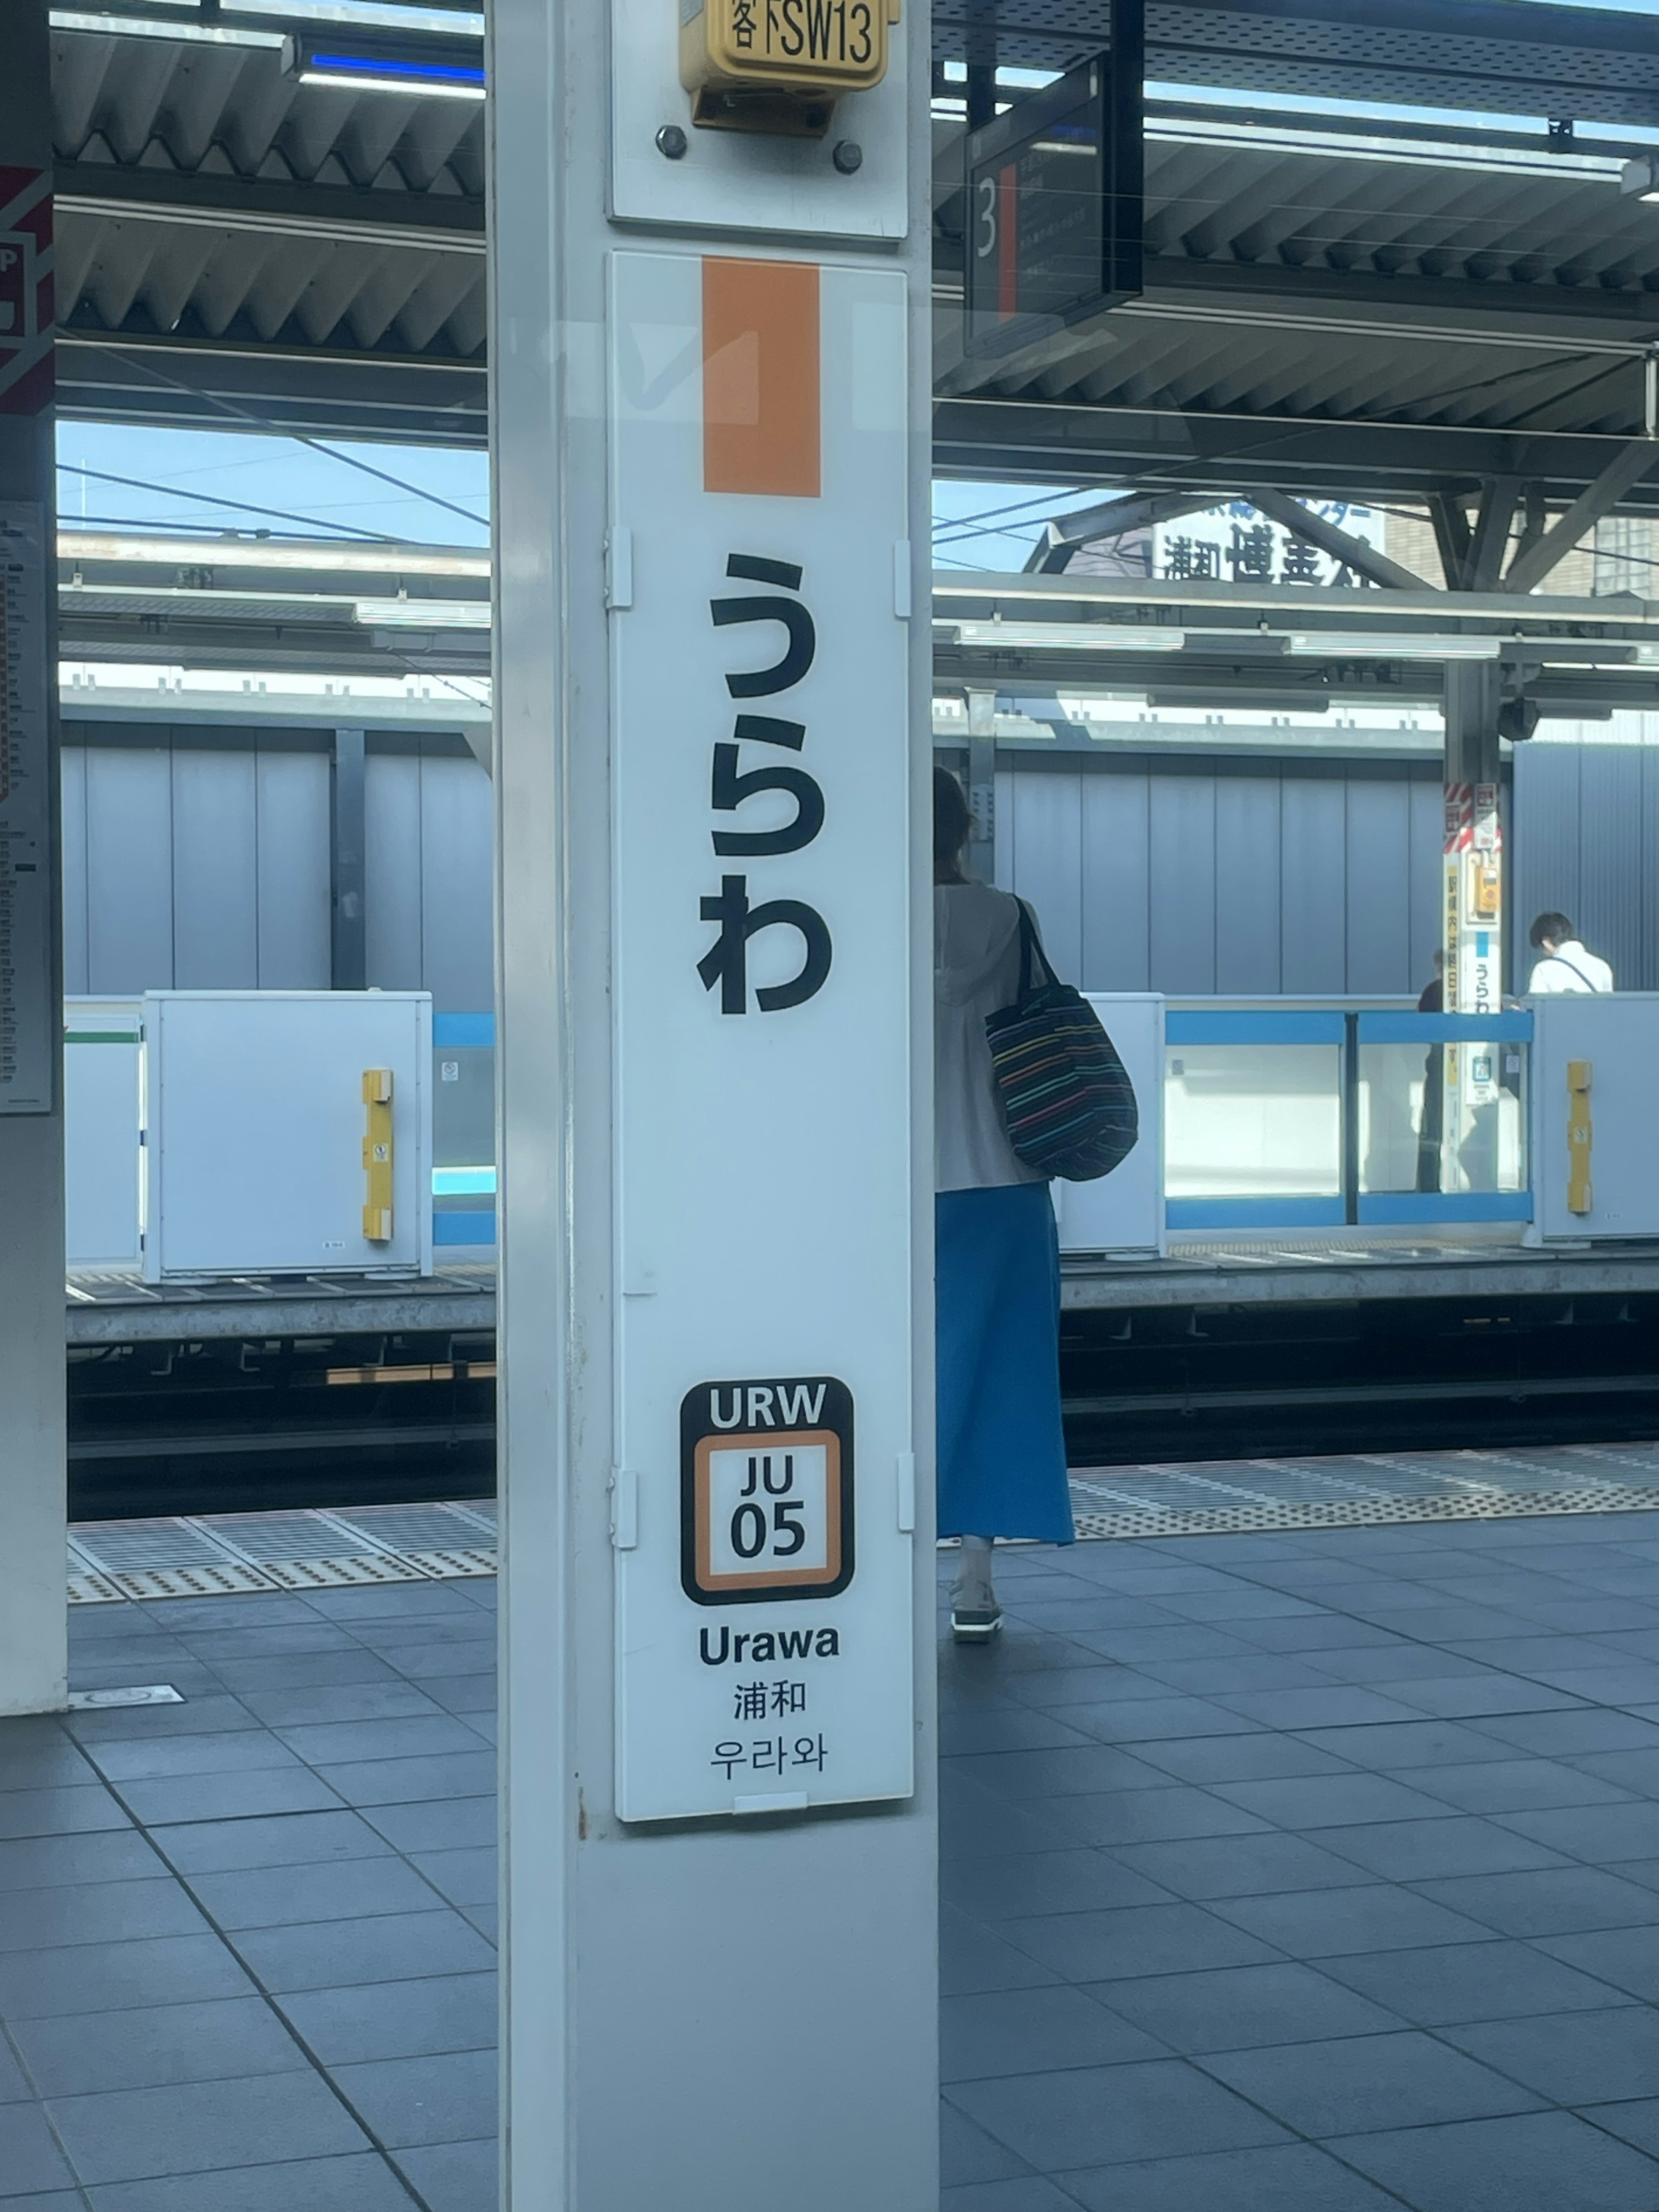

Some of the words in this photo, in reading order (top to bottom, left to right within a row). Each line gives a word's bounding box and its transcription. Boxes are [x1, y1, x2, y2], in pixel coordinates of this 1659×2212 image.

[978, 177, 995, 258] 3
[696, 553, 833, 1015] うらわ
[710, 1383, 827, 1429] URW
[740, 1455, 793, 1497] JU
[730, 1500, 806, 1558] 05
[699, 1626, 839, 1665] Urawa
[734, 1679, 806, 1720] 浦和
[710, 1732, 828, 1780] 우라와
